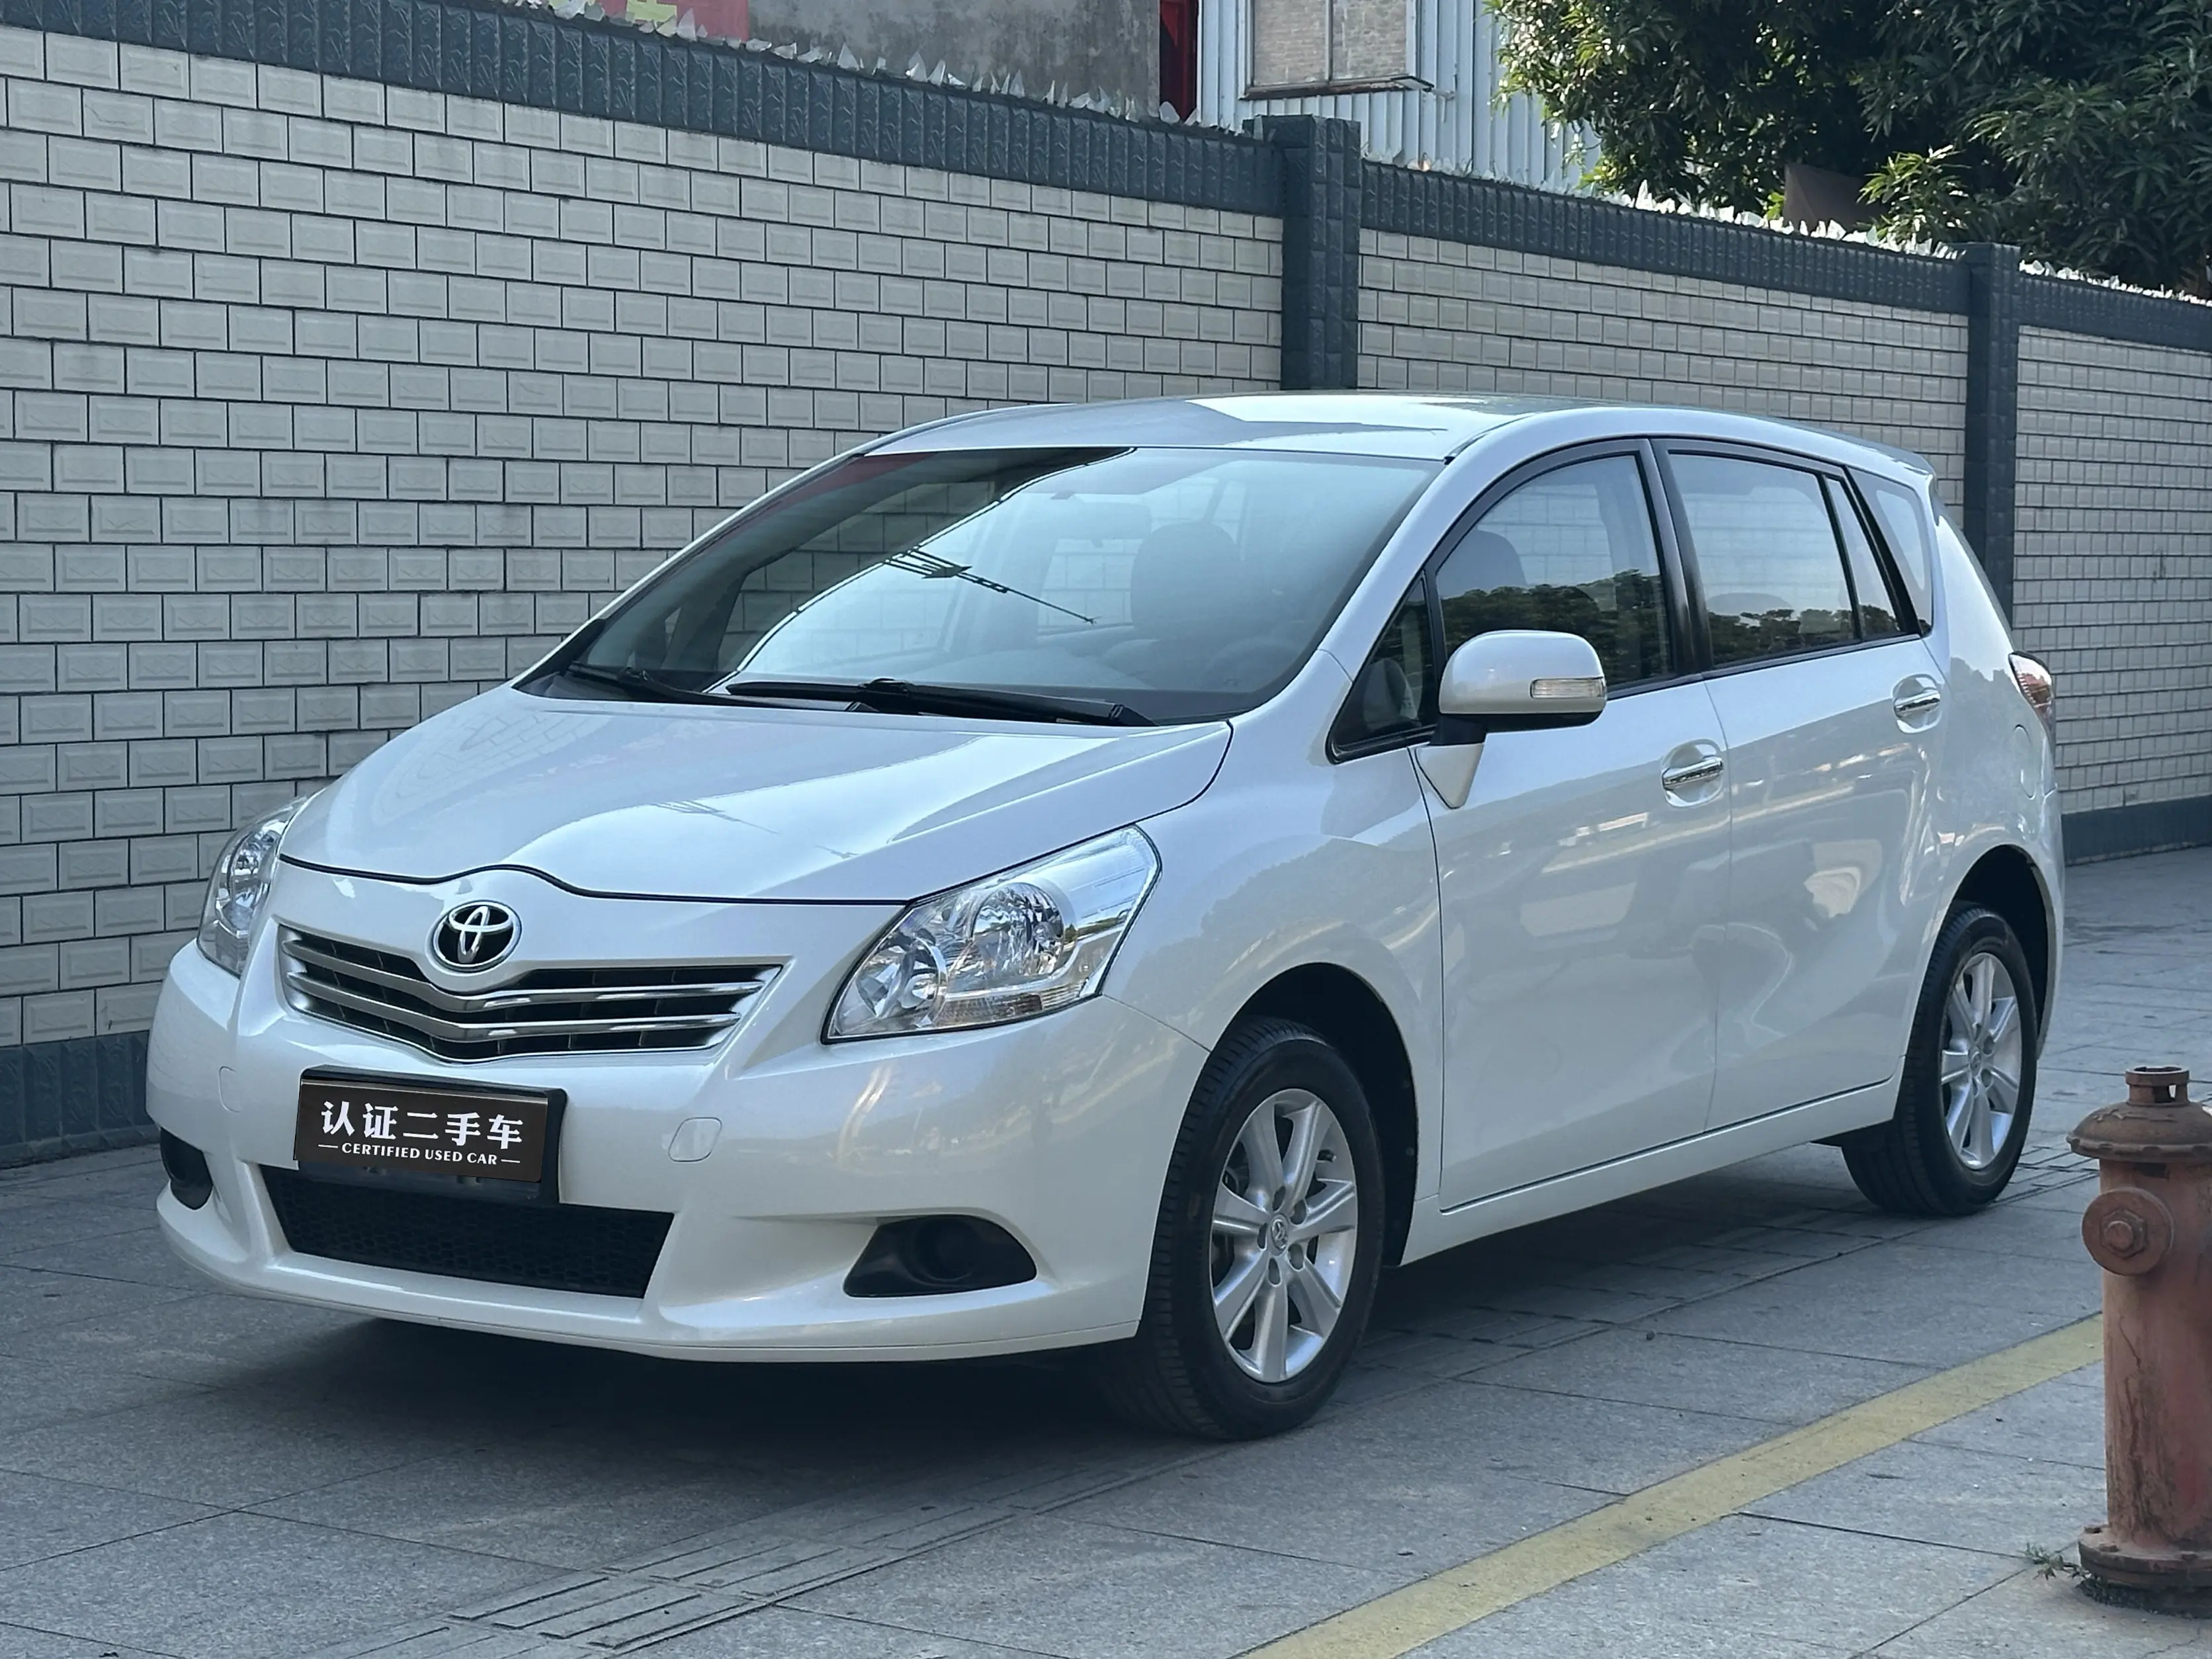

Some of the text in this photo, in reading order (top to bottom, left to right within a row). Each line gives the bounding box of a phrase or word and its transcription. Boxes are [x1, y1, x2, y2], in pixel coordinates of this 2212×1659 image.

[321, 1101, 524, 1150] 认证二手车
[341, 1142, 497, 1165] CERTIFIED USED CAR
